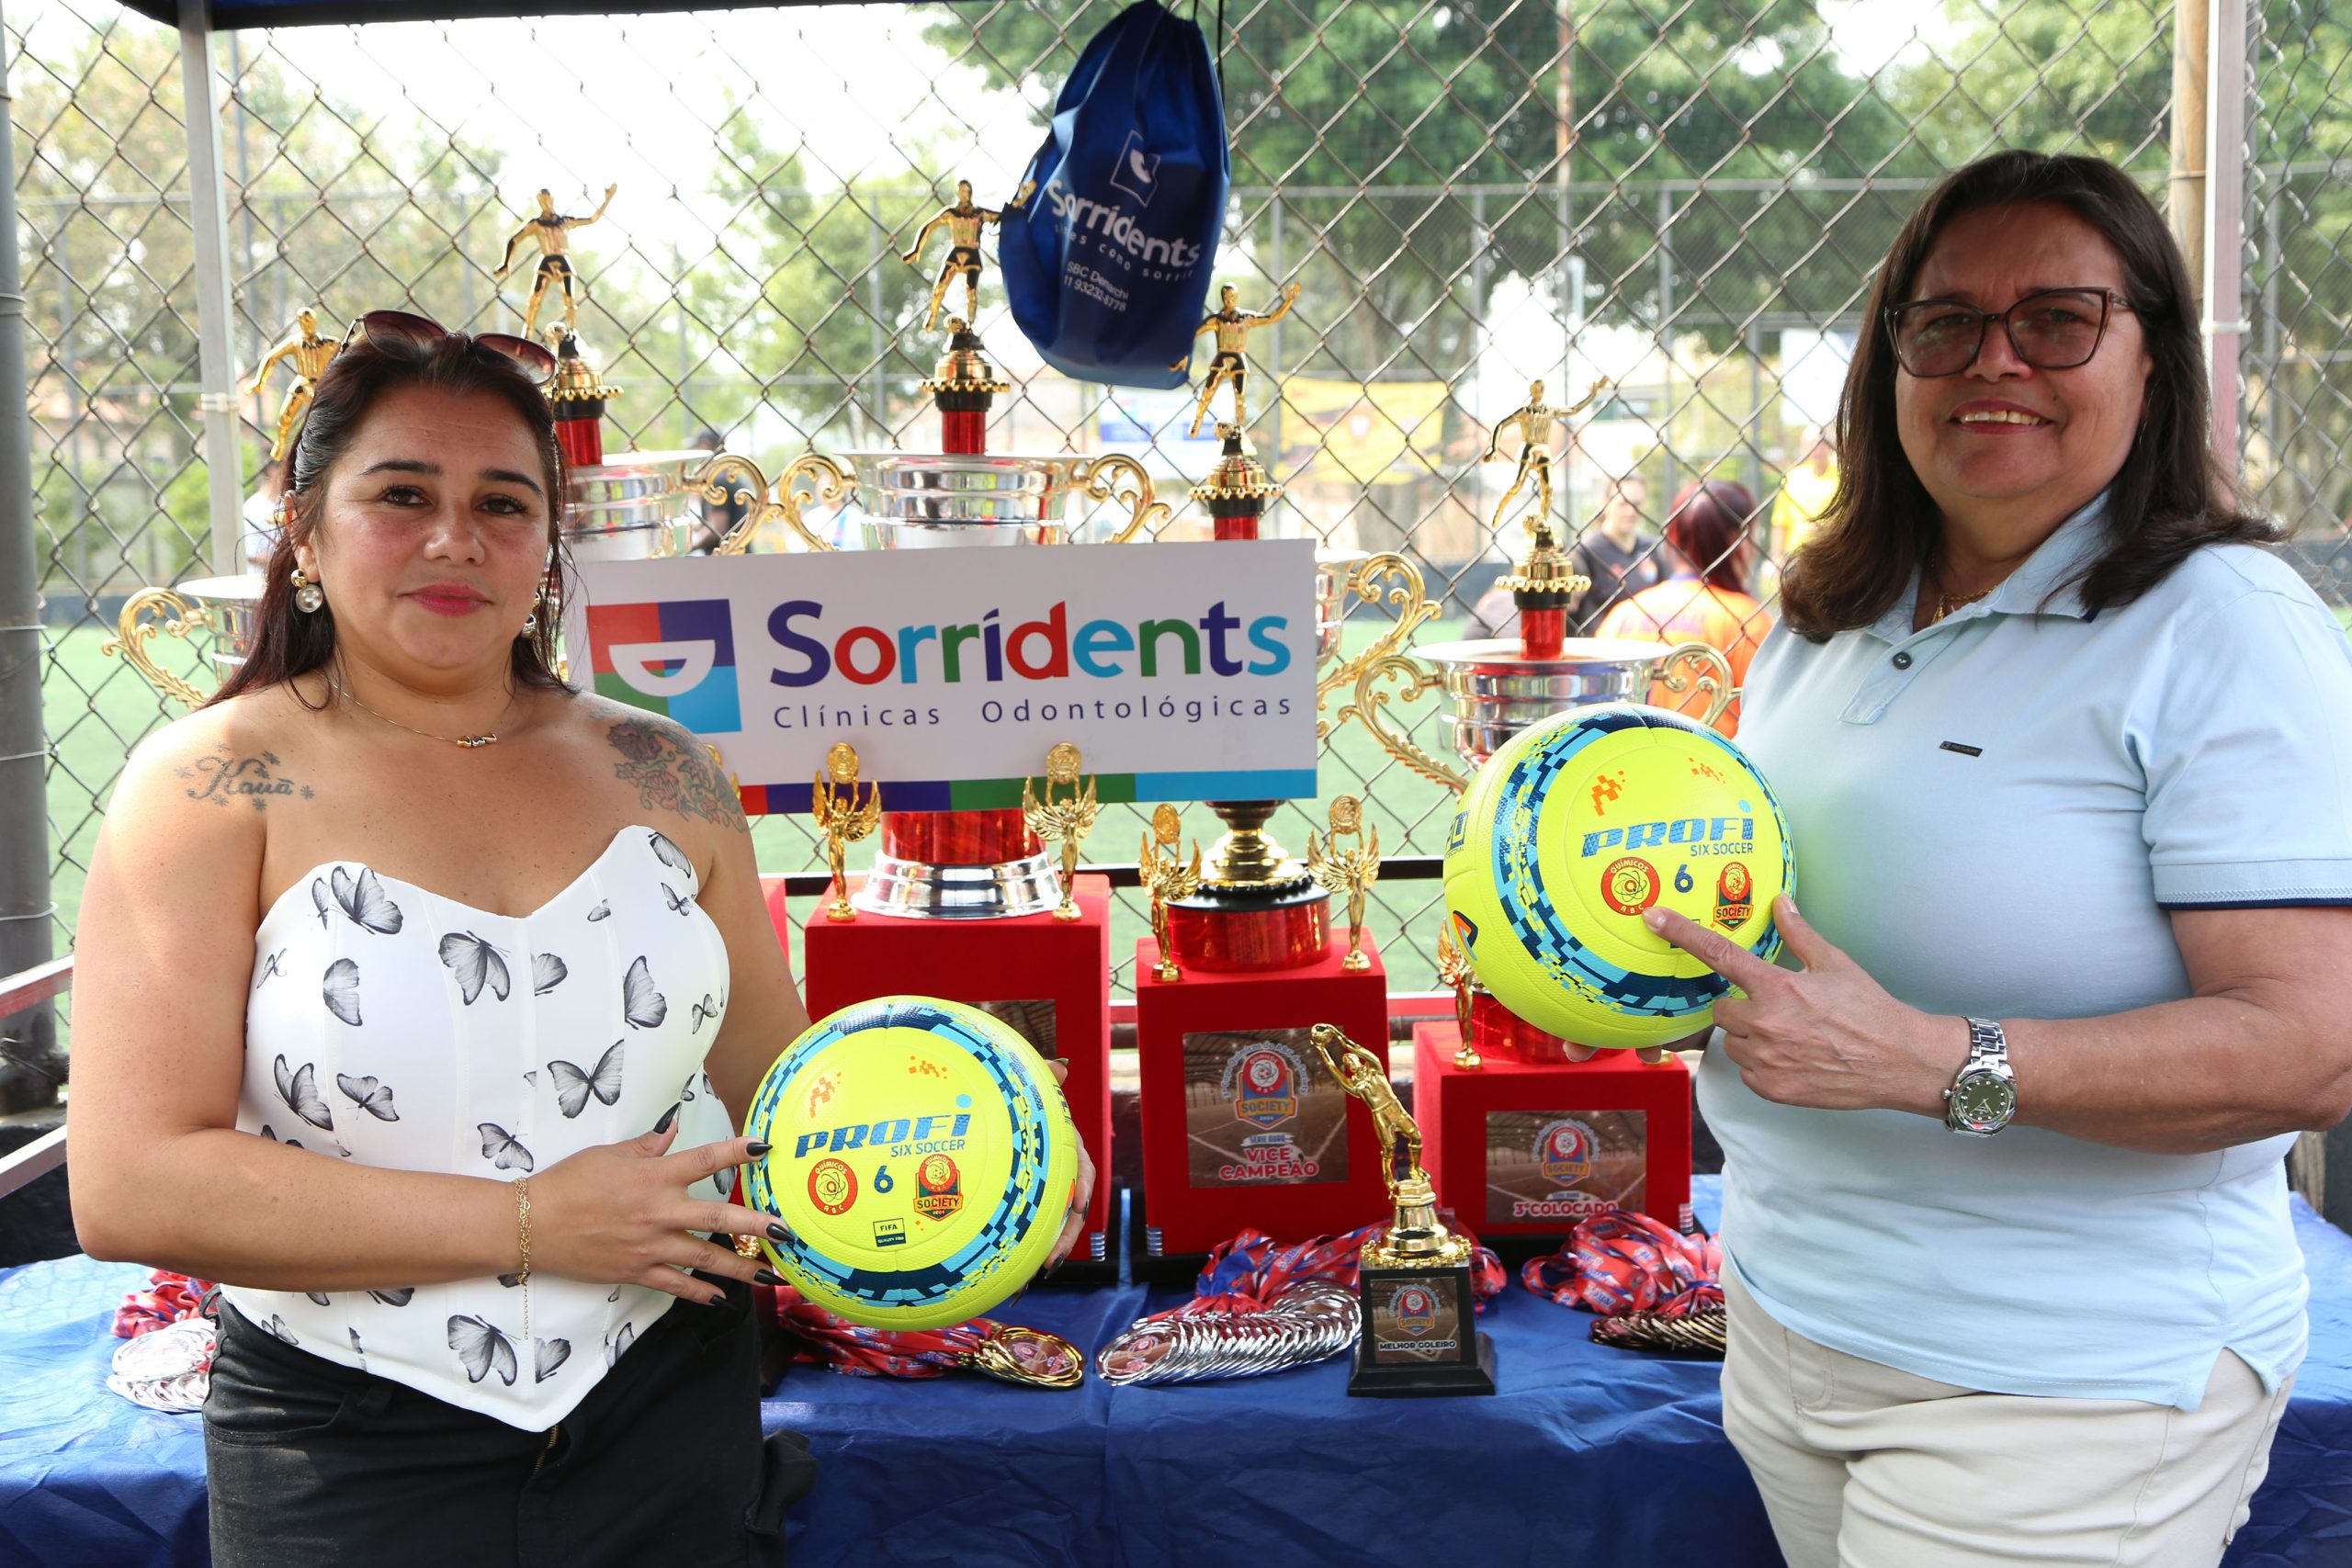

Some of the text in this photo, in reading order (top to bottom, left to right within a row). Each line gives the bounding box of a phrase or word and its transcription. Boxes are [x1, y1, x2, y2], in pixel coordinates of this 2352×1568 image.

[1067, 261, 1090, 278] SBC
[775, 695, 1290, 728] Clínicas Odontológicas
[1690, 842, 1753, 856] SIX SOCCER
[1675, 863, 1693, 893] 6
[1716, 906, 1751, 919] SOCIETY
[1241, 1100, 1290, 1113] SOCIETY
[890, 1139, 966, 1157] SIX SOCCER
[1245, 1146, 1291, 1163] VICE
[1220, 1159, 1319, 1180] CAMPEÃO
[874, 1165, 894, 1193] 6
[917, 1197, 960, 1209] SOCIETY
